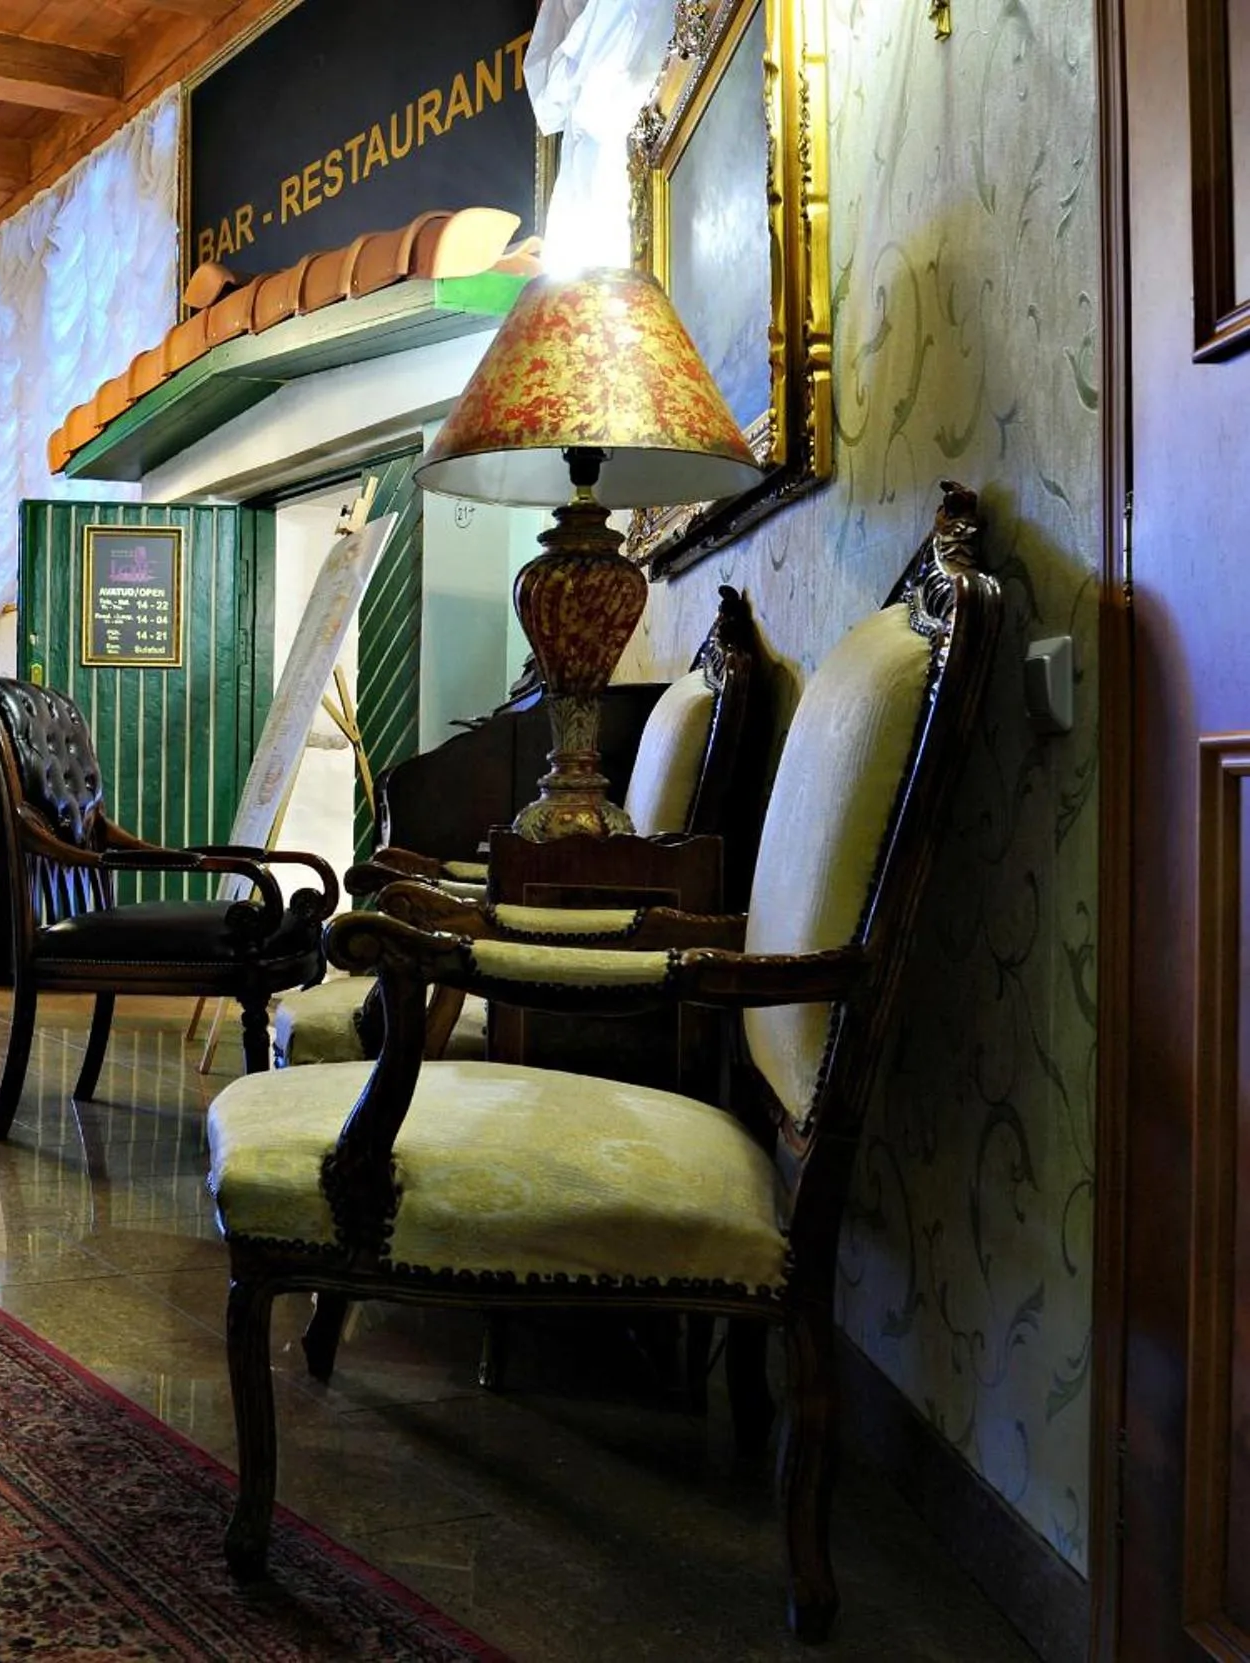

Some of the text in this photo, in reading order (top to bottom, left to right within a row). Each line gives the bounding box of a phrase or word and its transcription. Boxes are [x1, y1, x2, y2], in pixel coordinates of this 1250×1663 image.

[198, 204, 255, 264] BAR
[280, 30, 532, 225] RESTAURANT
[136, 600, 148, 610] 14
[156, 601, 169, 611] 22
[136, 614, 148, 624] 14
[156, 615, 168, 624] 04
[136, 631, 148, 640] 14
[156, 631, 167, 641] 21
